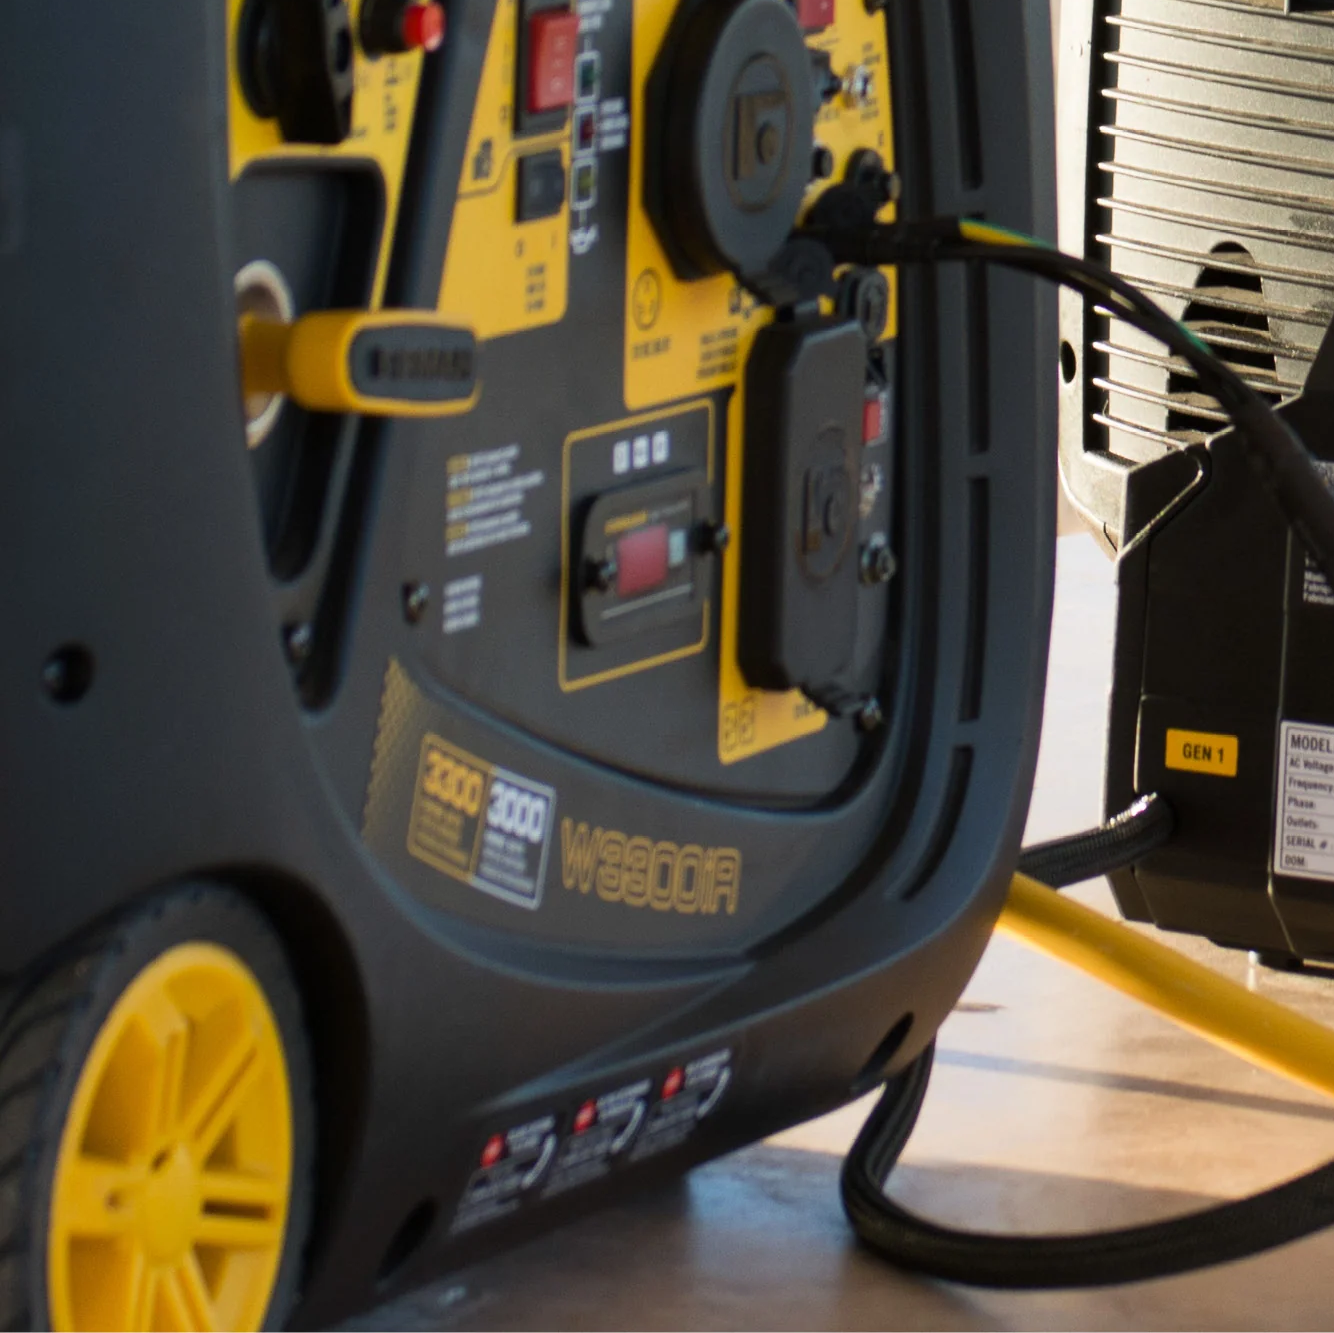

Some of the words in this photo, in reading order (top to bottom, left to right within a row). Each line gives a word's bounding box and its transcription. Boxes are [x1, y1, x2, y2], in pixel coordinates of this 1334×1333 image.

[1183, 742, 1212, 763] GEN
[1217, 747, 1224, 764] 1
[1289, 757, 1300, 769] AC
[486, 780, 546, 844] 3000
[1285, 835, 1315, 849] SERIAL
